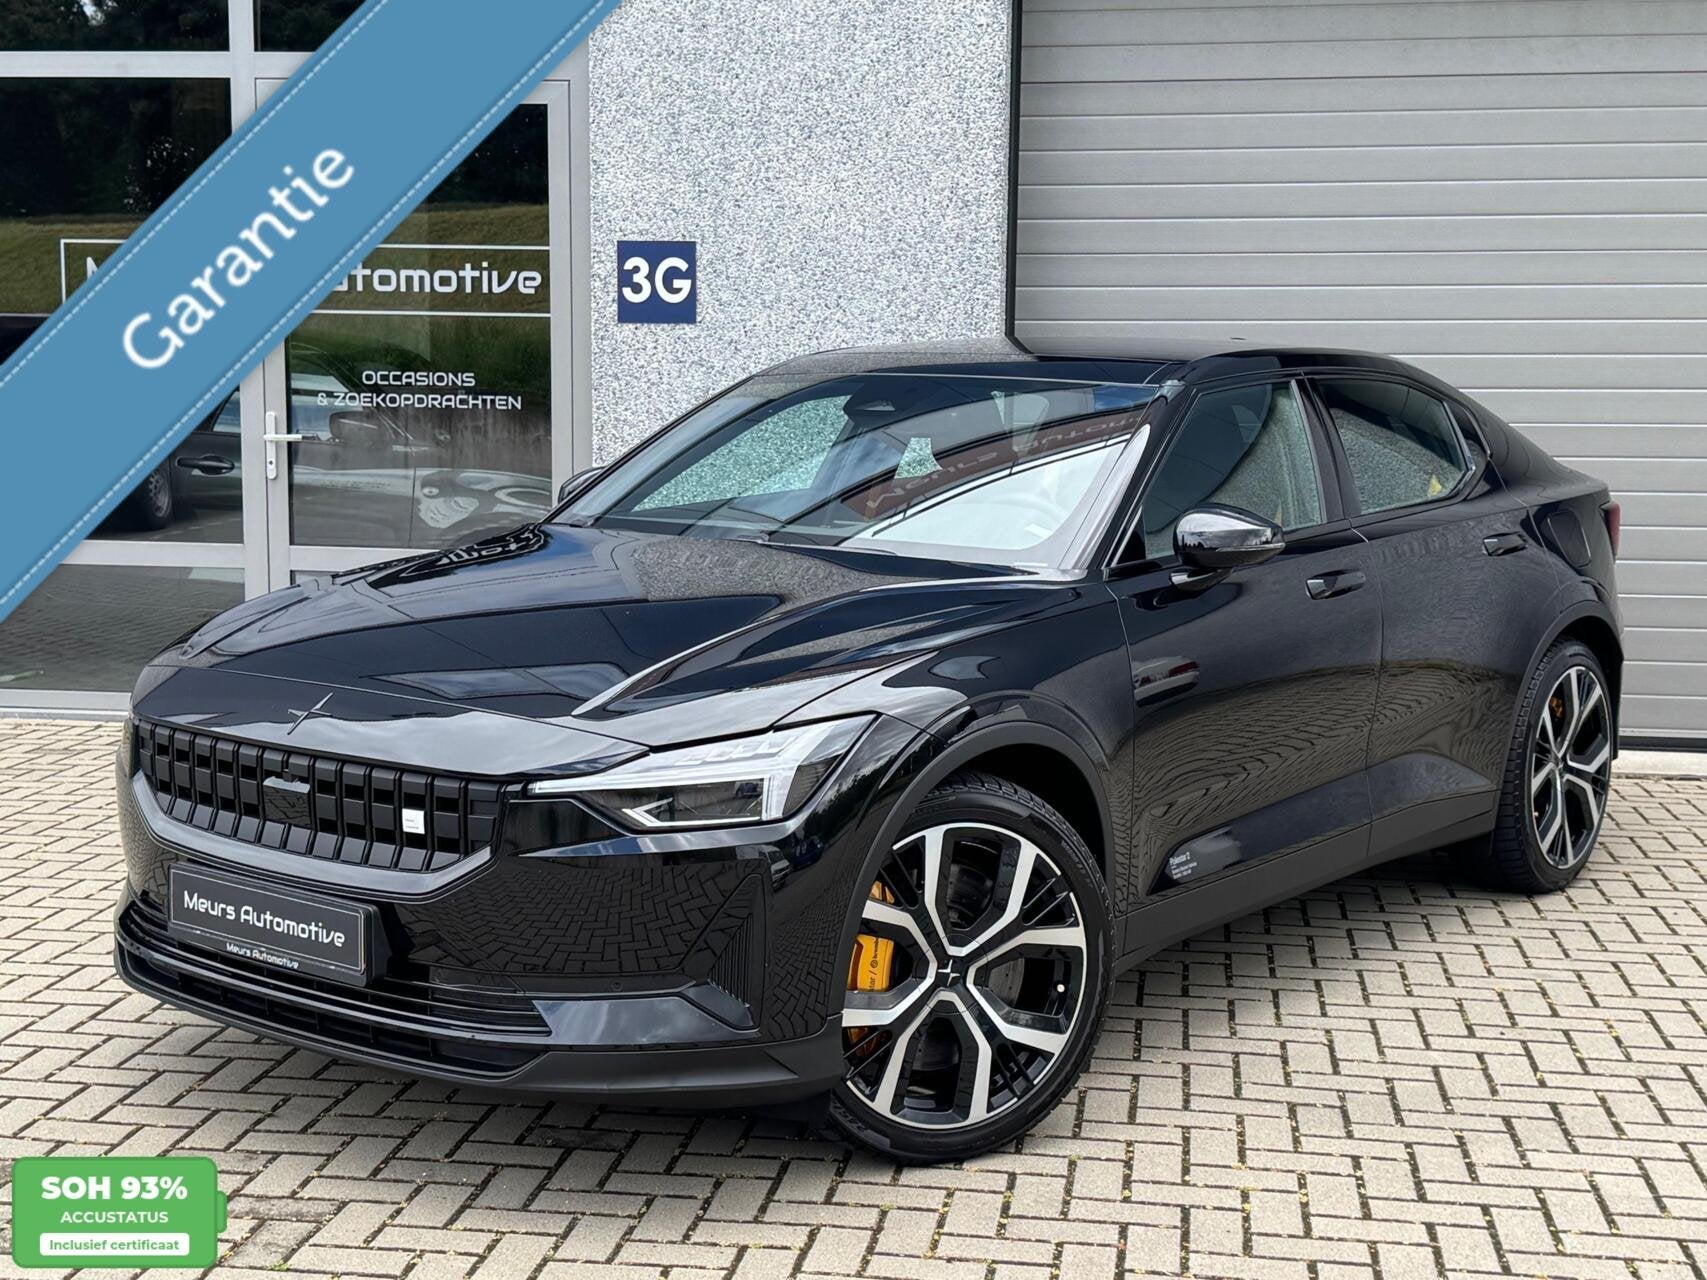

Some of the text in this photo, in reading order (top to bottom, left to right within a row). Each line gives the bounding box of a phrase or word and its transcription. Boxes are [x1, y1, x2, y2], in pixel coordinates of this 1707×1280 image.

[335, 261, 542, 294] tomotive
[621, 256, 692, 304] 3G
[361, 370, 476, 387] OCCASIONS
[317, 392, 522, 410] & ZOEKOPDRACHTEN
[183, 890, 345, 947] Meurs Automotive
[226, 942, 299, 970] Meurs Automotive
